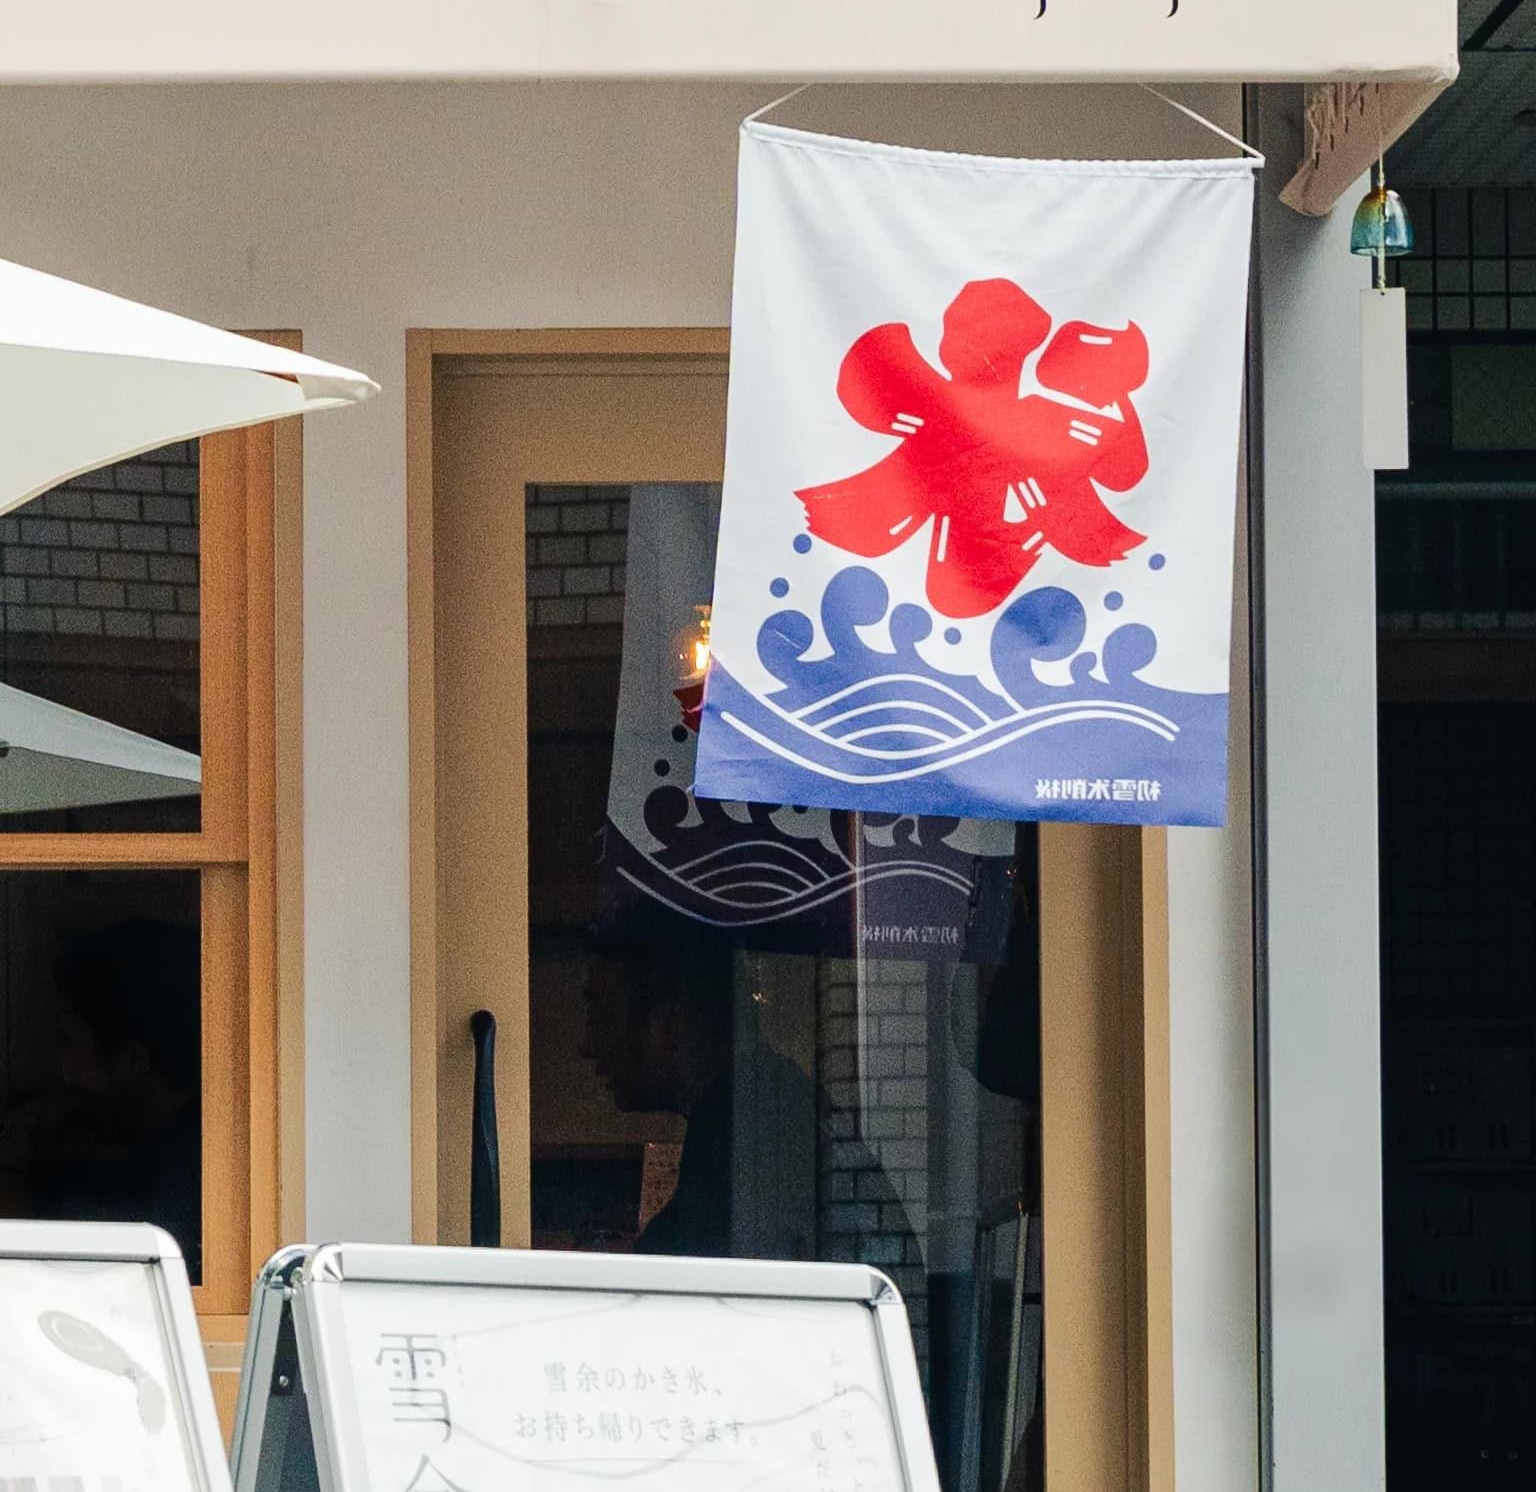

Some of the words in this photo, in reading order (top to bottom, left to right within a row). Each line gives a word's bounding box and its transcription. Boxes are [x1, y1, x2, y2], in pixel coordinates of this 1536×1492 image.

[543, 1361, 724, 1396] 雪余のかき氷、
[514, 1412, 758, 1446] お持ち帰りできます。
